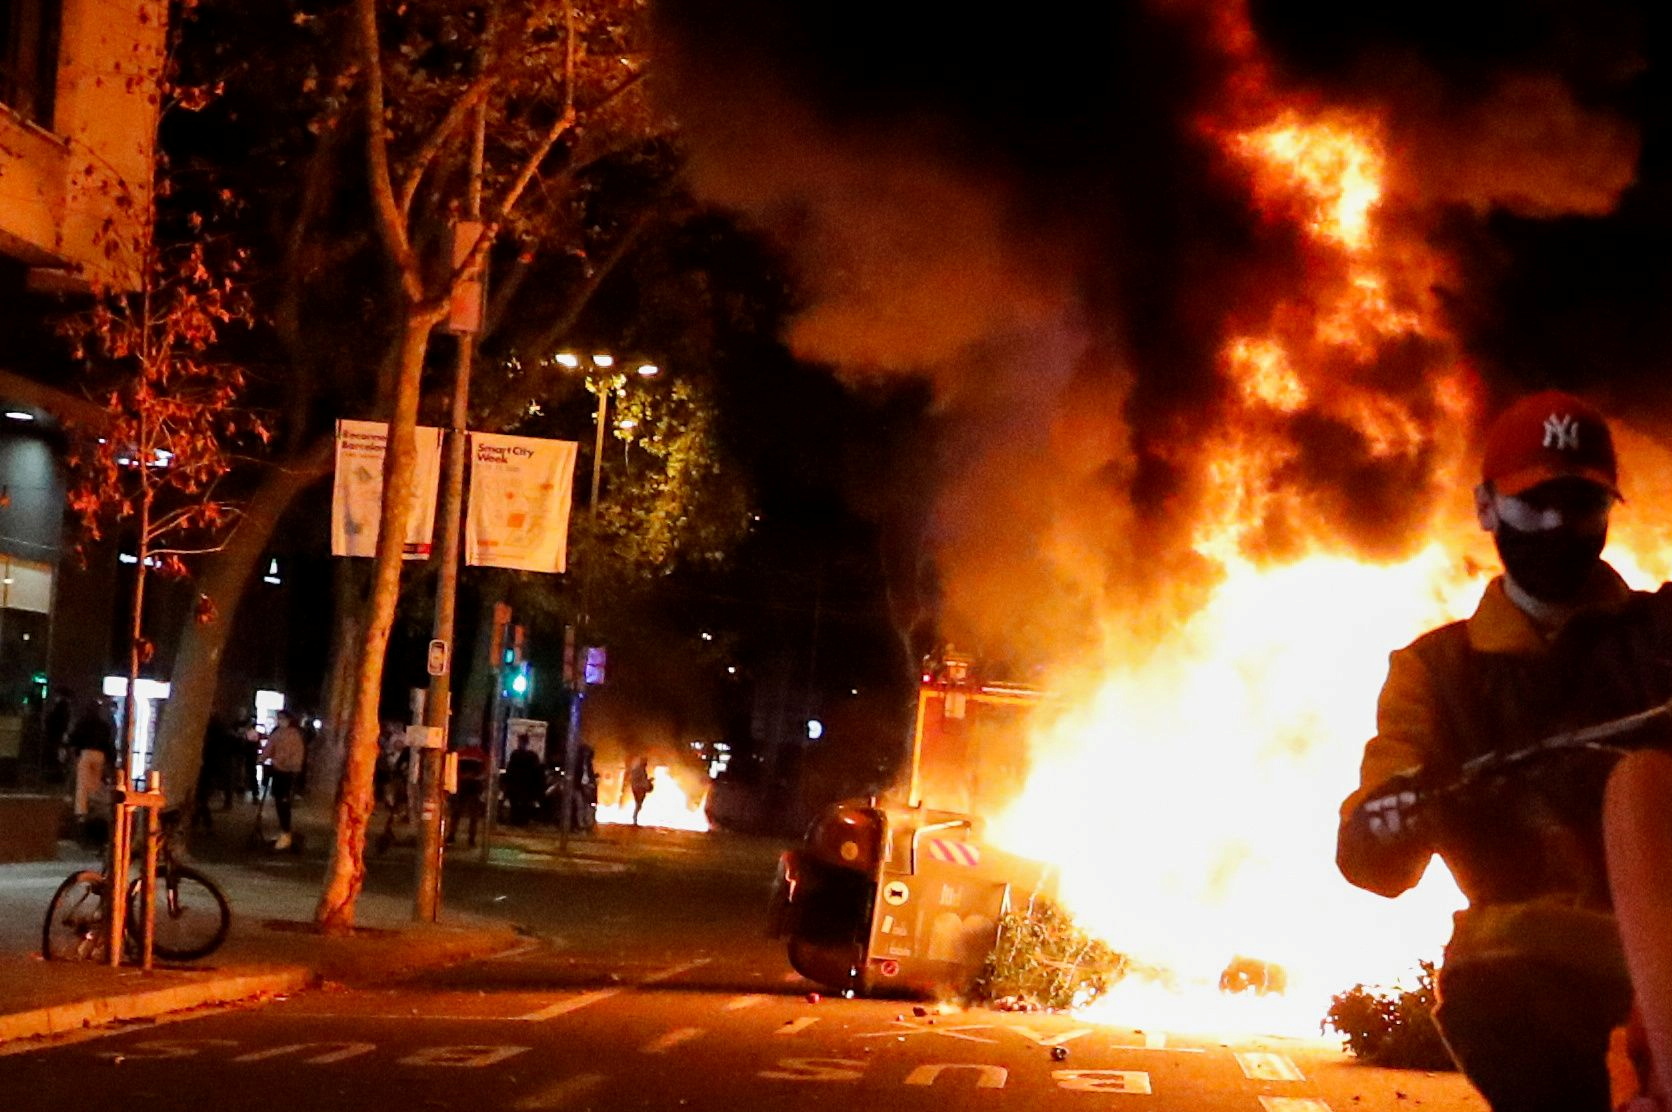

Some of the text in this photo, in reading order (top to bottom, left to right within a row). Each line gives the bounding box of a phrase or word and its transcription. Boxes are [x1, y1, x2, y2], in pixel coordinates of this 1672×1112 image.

[1543, 413, 1579, 449] NY
[477, 453, 508, 464] Week
[478, 443, 534, 459] Smart City
[757, 1057, 1152, 1095] BUS
